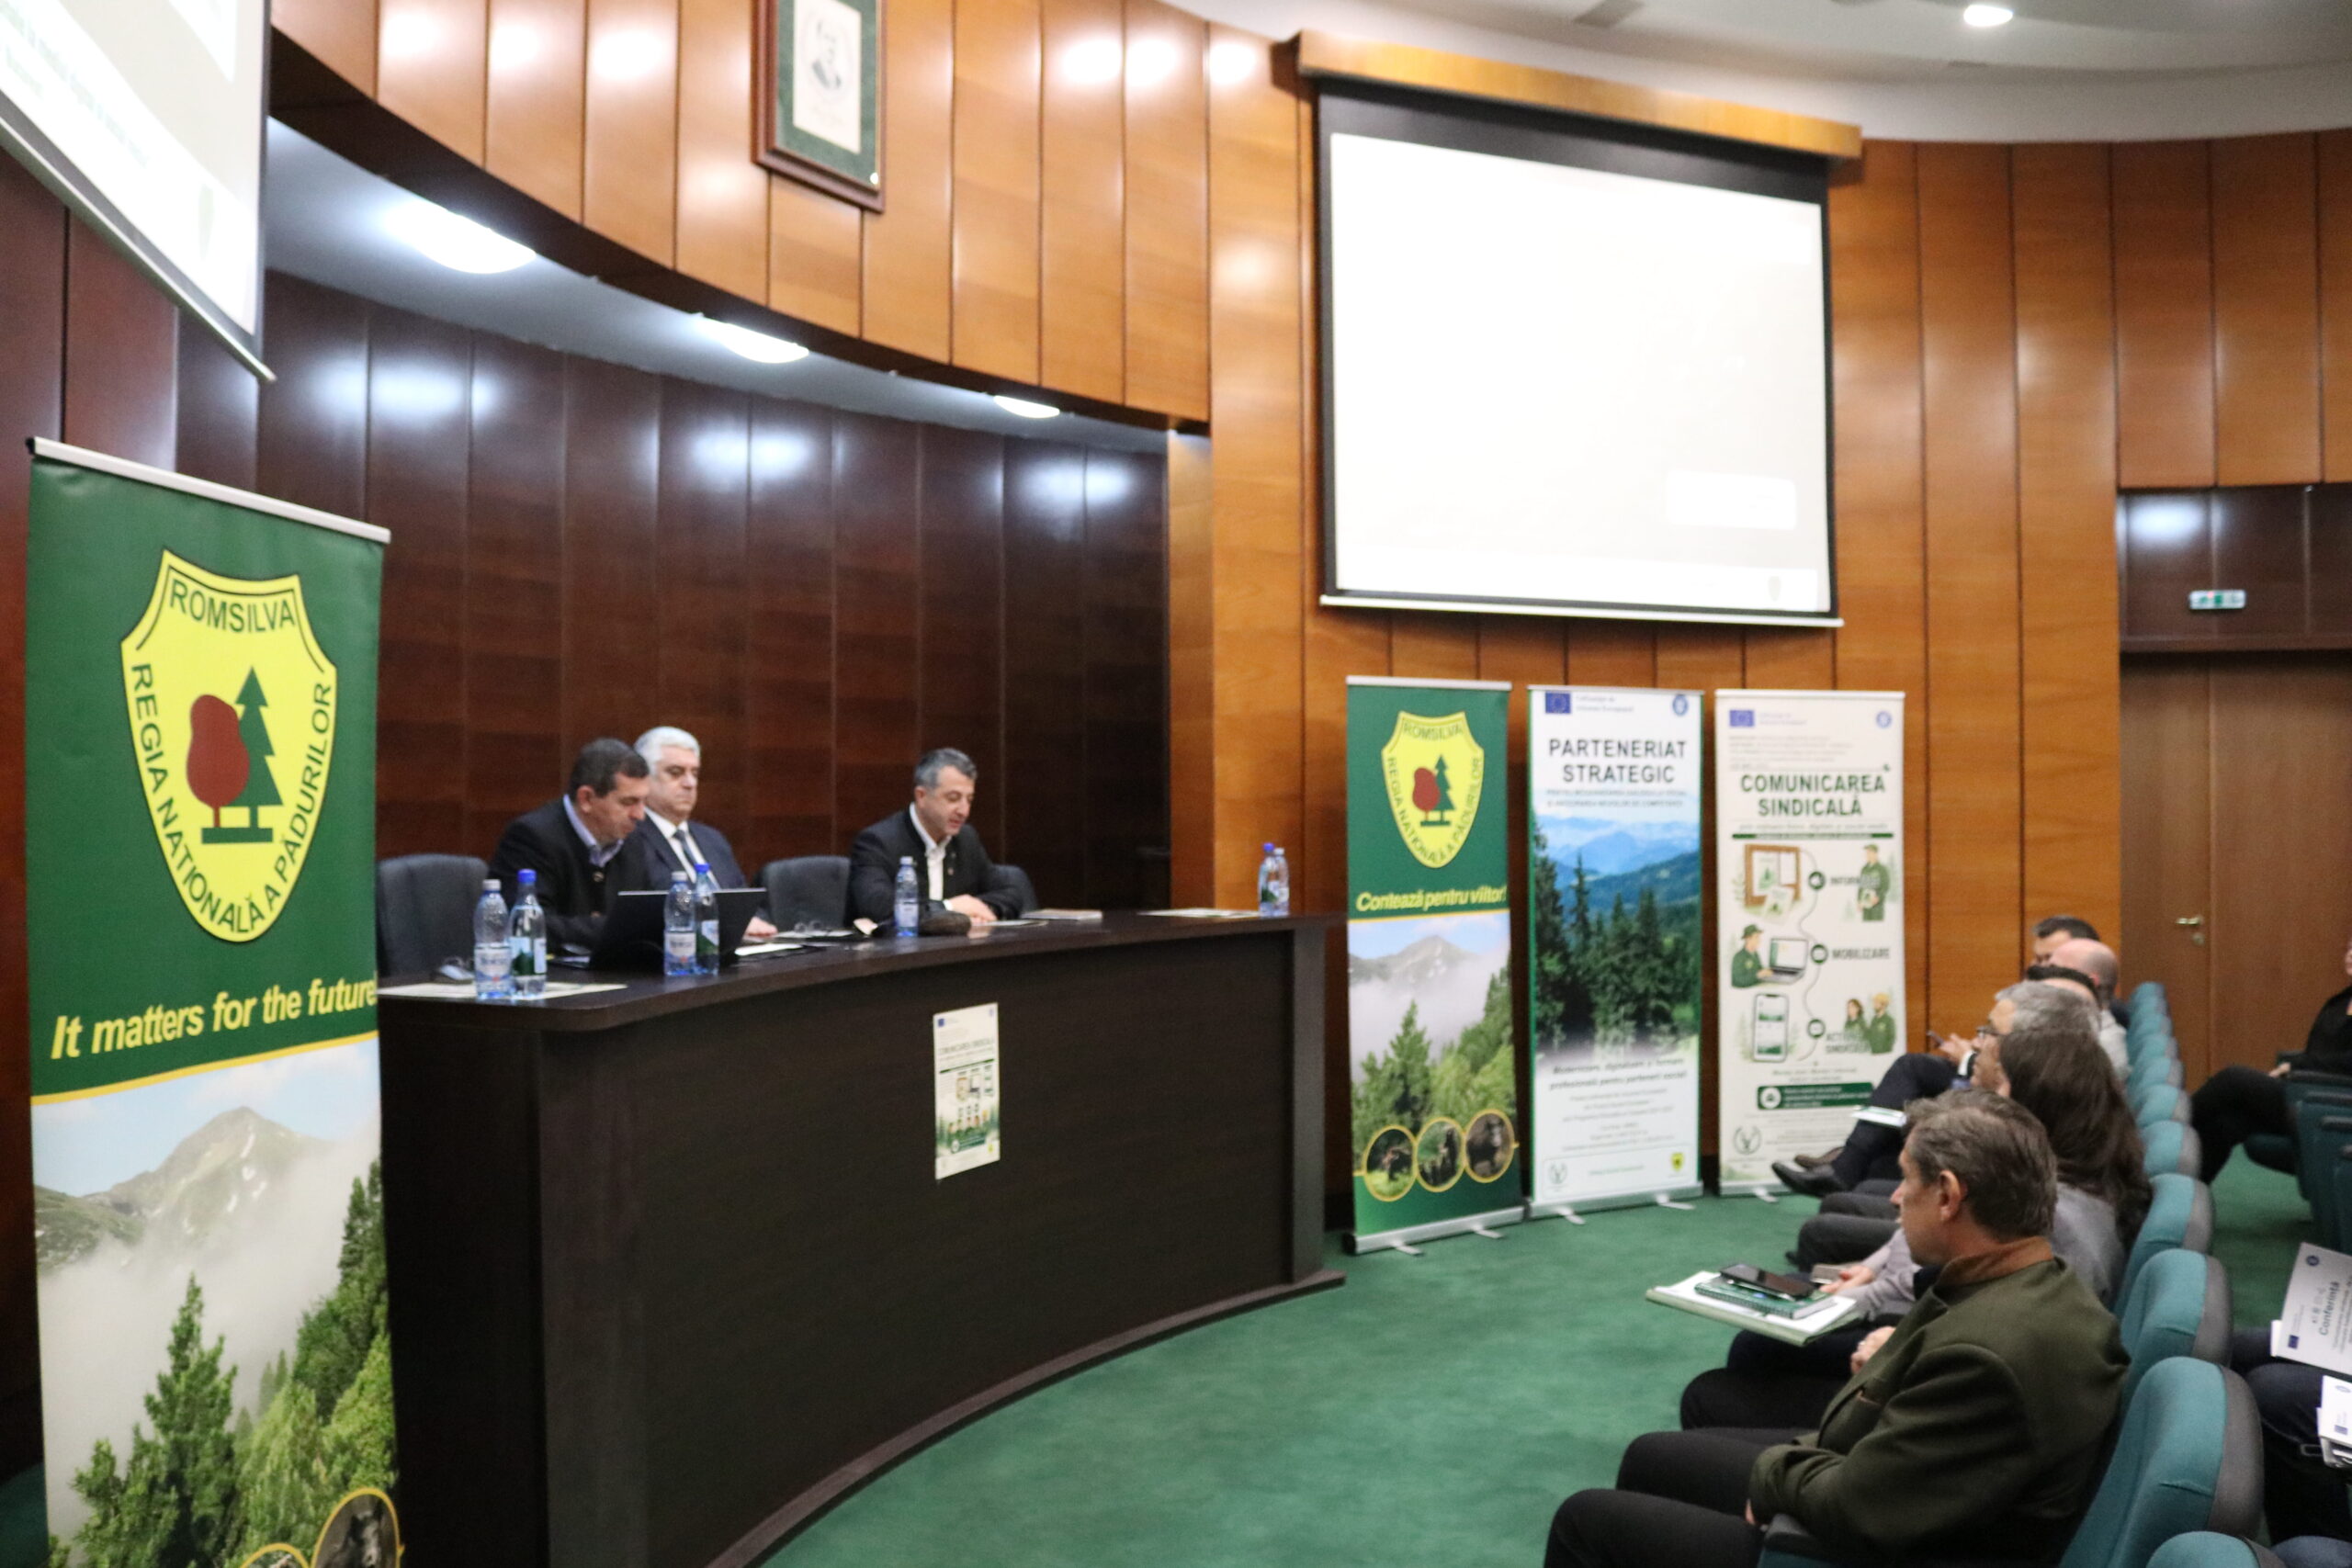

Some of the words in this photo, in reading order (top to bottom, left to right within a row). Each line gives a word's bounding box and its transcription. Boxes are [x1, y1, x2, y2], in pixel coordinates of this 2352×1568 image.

[169, 579, 296, 633] ROMSILVA
[1403, 722, 1464, 740] ROMSILVA
[1548, 738, 1688, 759] PARTENERIAT
[1563, 763, 1675, 784] STRATEGIC
[1740, 773, 1886, 793] COMUNICAREA
[131, 663, 169, 795] REGIA
[264, 884, 282, 912] A
[273, 682, 332, 883] PĂDURILOR
[1423, 887, 1469, 911] pentru
[51, 1015, 84, 1060] It
[91, 1003, 206, 1055] matters
[211, 991, 257, 1032] for
[262, 984, 302, 1024] the
